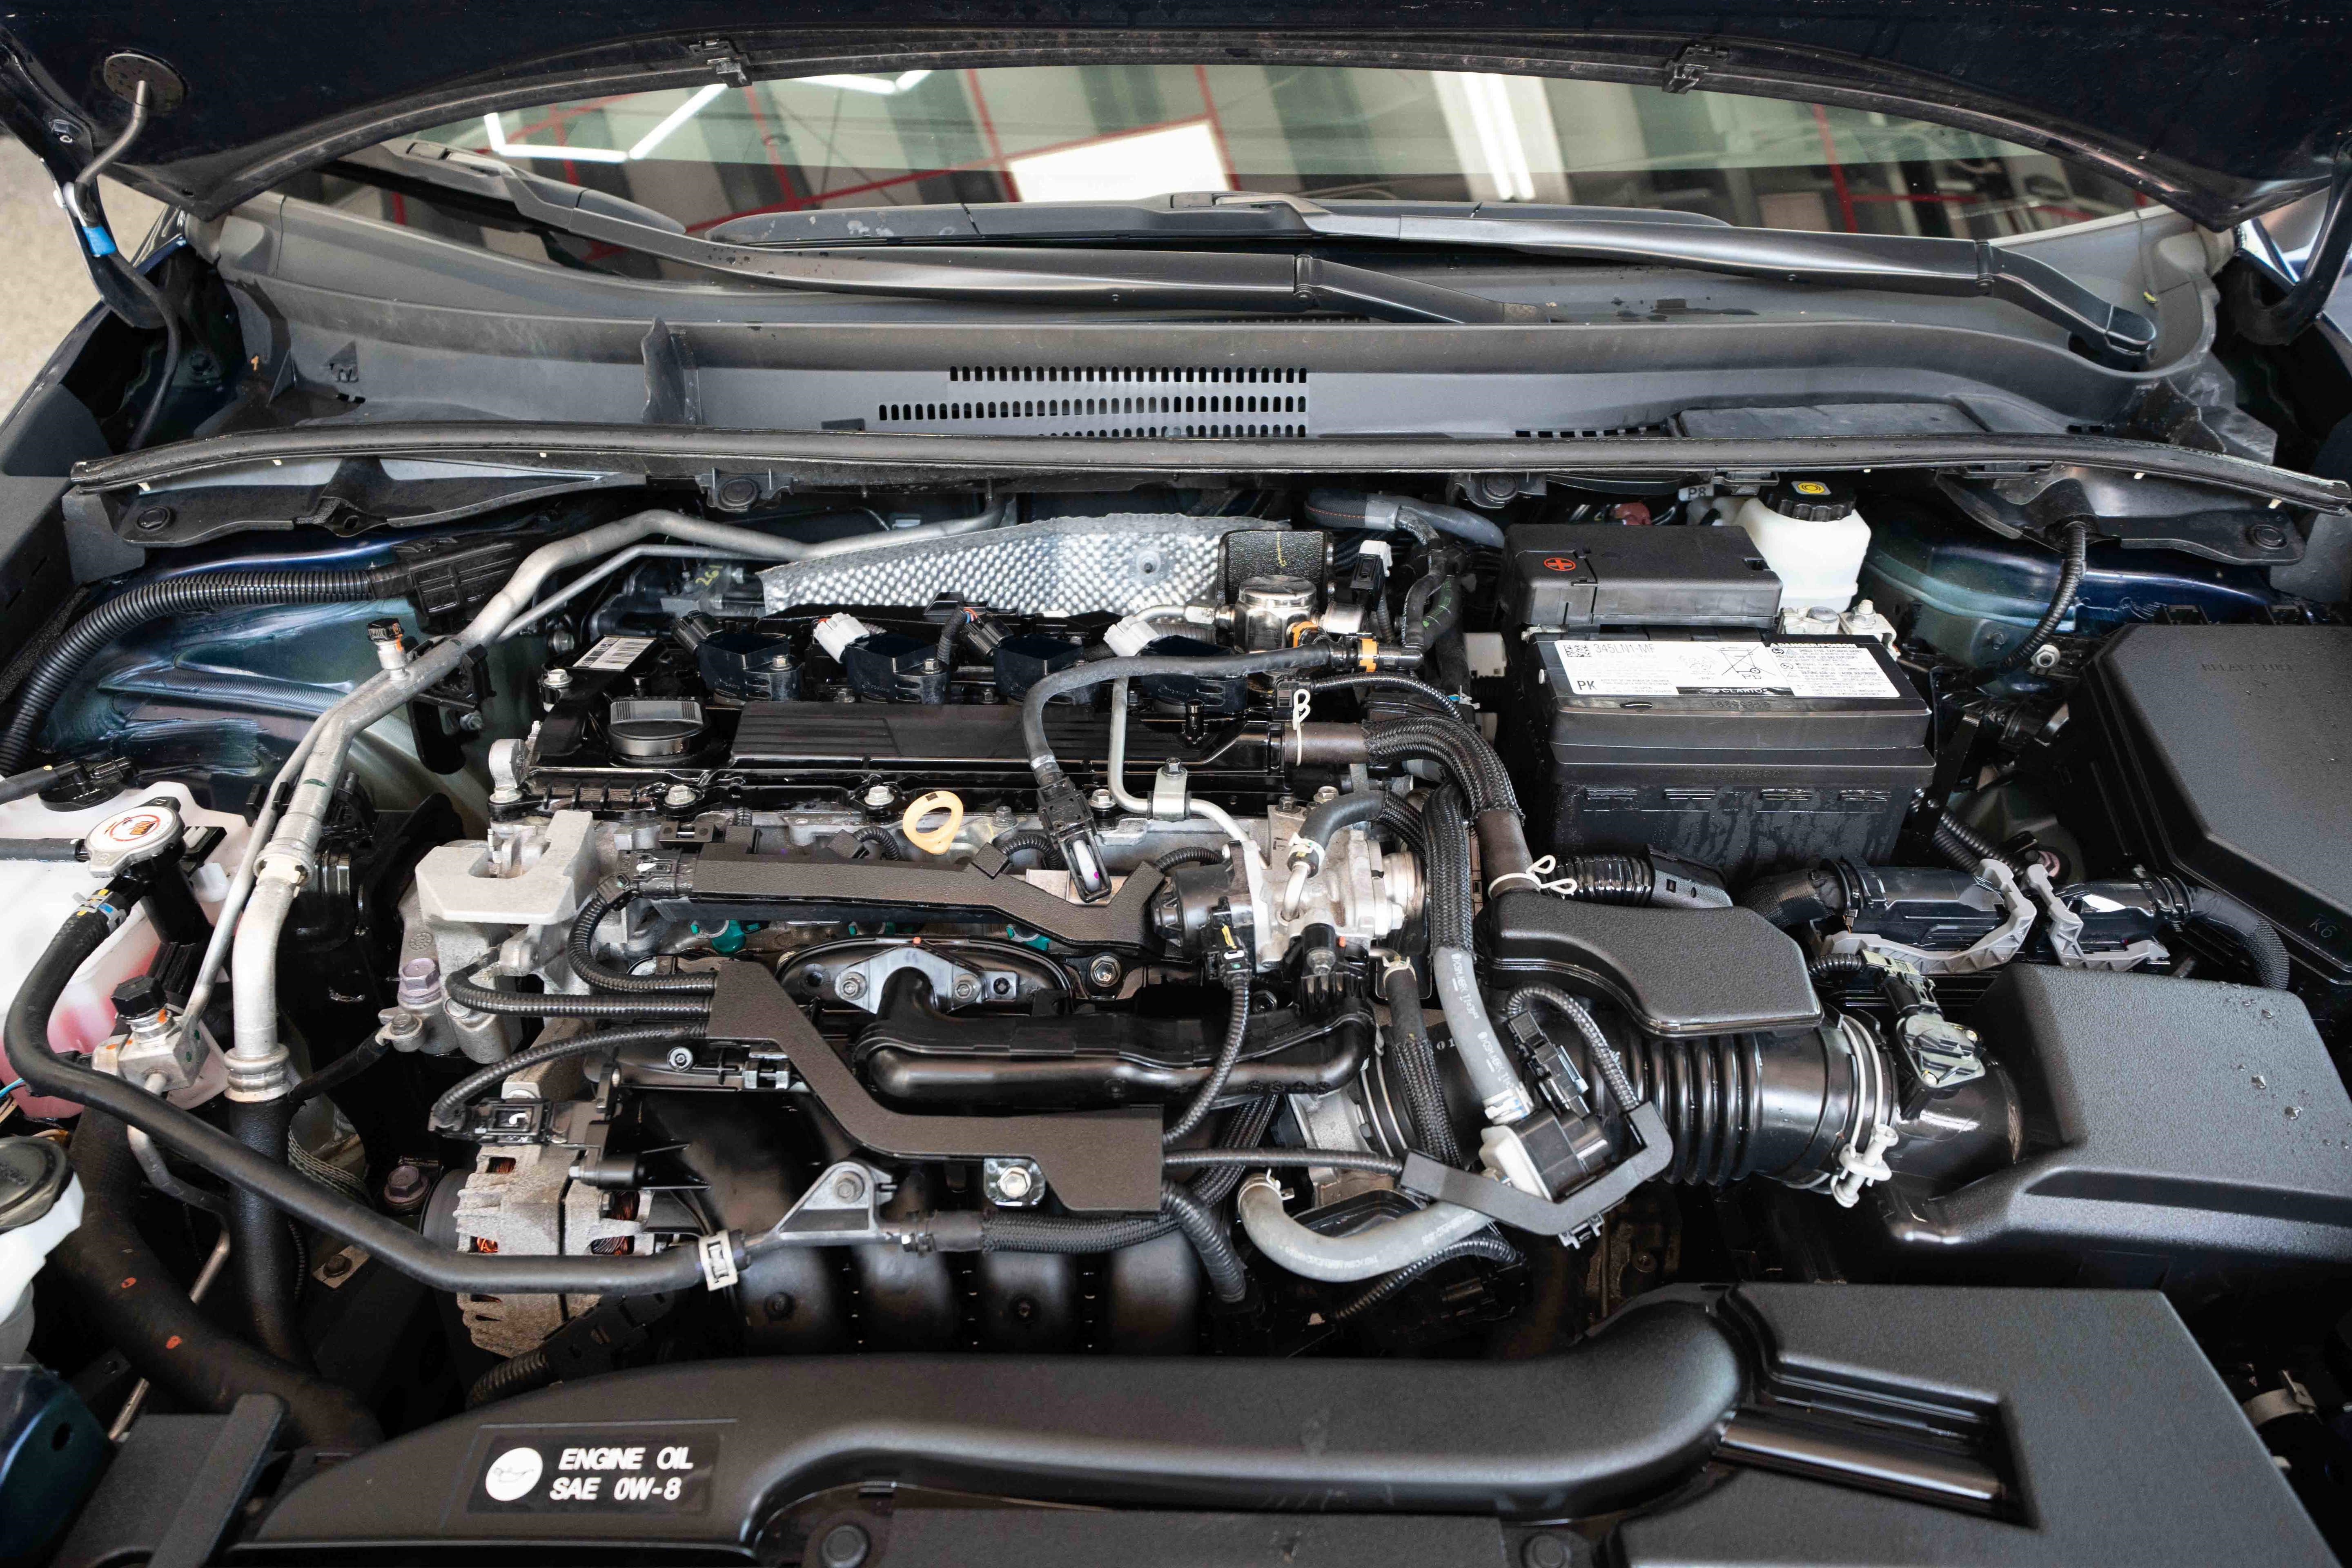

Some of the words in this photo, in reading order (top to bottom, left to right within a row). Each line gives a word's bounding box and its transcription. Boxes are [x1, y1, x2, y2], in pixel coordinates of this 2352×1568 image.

[1688, 486, 1706, 499] P8
[1593, 644, 1655, 653] 345LN1-MF
[1577, 680, 1596, 690] PK
[558, 1447, 646, 1470] ENGINE
[656, 1446, 694, 1470] OIL
[549, 1477, 601, 1500] SAE
[613, 1477, 682, 1501] 0W-8
